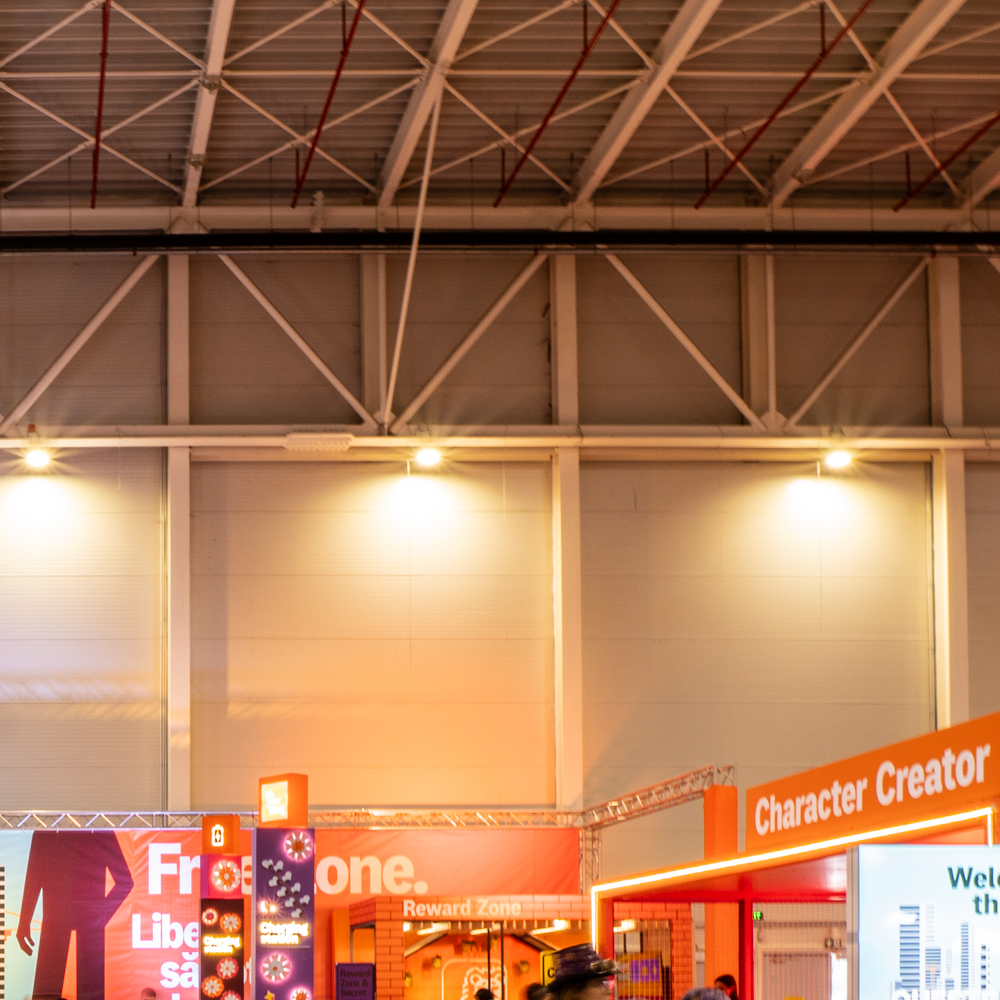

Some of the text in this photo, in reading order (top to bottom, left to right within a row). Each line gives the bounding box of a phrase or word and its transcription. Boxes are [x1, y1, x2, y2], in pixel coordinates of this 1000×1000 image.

[755, 743, 991, 836] Character Creator
[148, 843, 428, 895] Fre one.
[947, 866, 1000, 889] Wel
[403, 900, 521, 917] Reward Zone
[972, 893, 1000, 915] th
[132, 913, 199, 949] Libe
[340, 969, 371, 978] Reward
[340, 979, 360, 988] Zone
[340, 989, 366, 997] Secret
